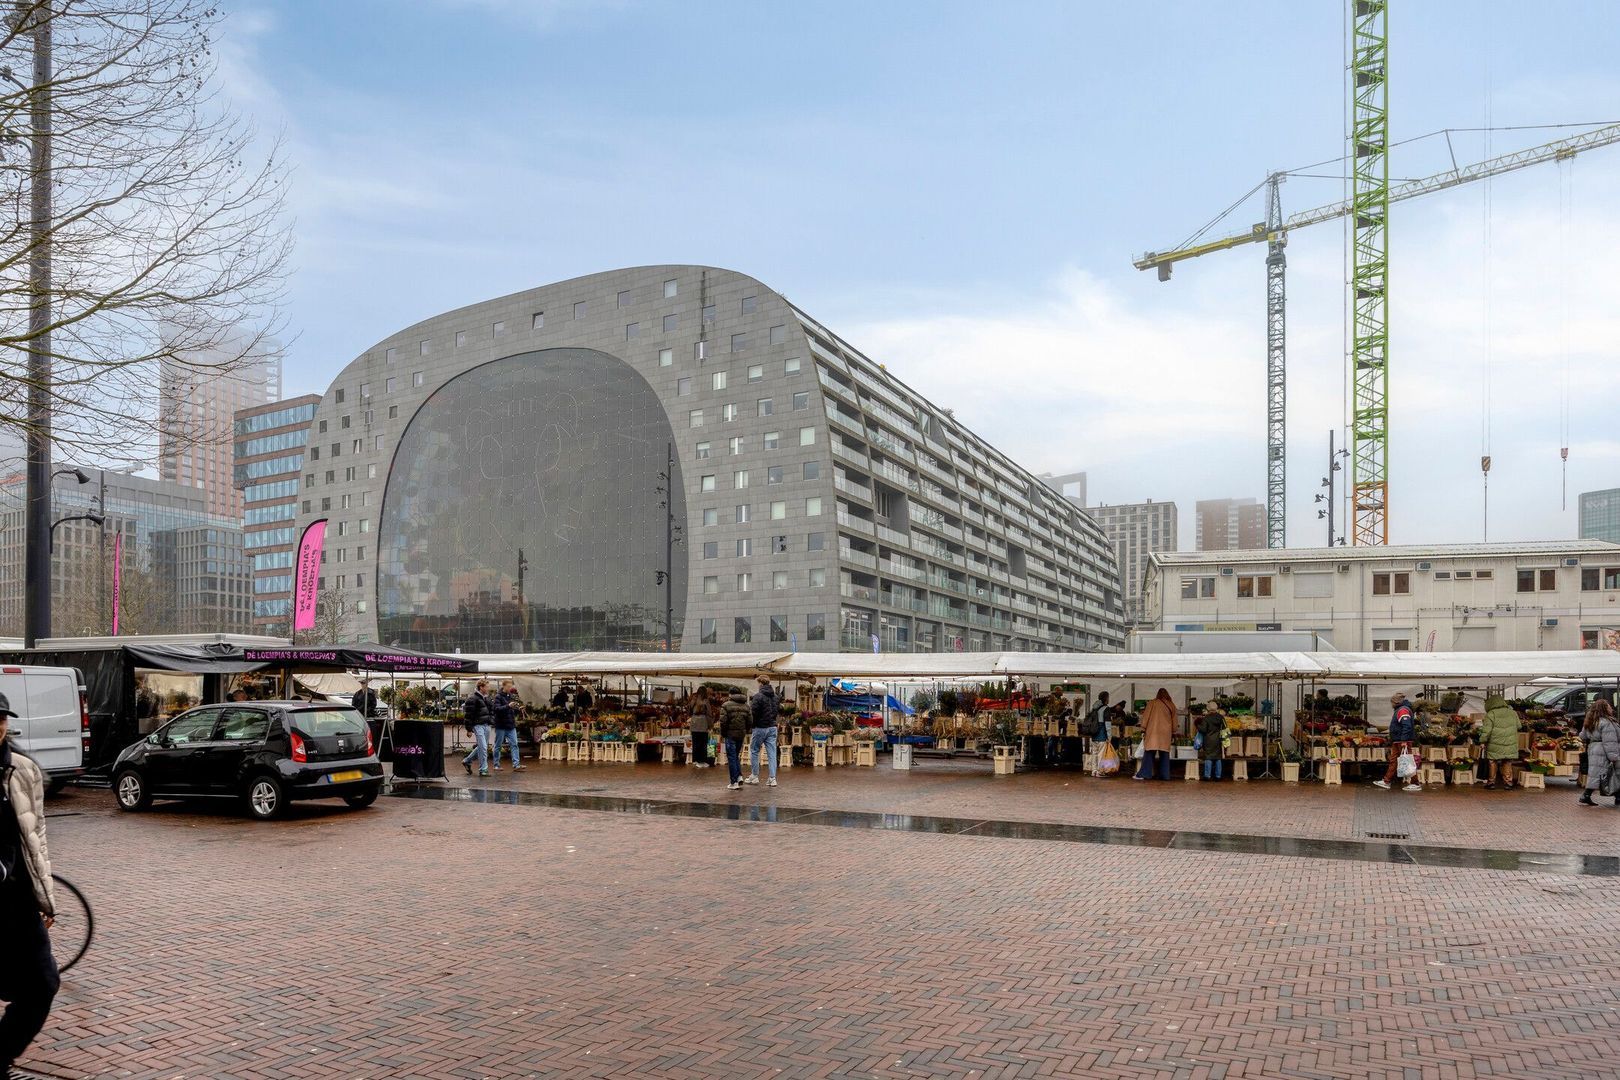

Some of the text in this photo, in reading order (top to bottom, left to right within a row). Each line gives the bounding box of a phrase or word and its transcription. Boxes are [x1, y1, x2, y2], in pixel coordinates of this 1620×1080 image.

[257, 651, 292, 659] LOEMPIA'S
[292, 651, 298, 660] &
[377, 655, 418, 664] LOEMPIA'S
[419, 657, 425, 665] &
